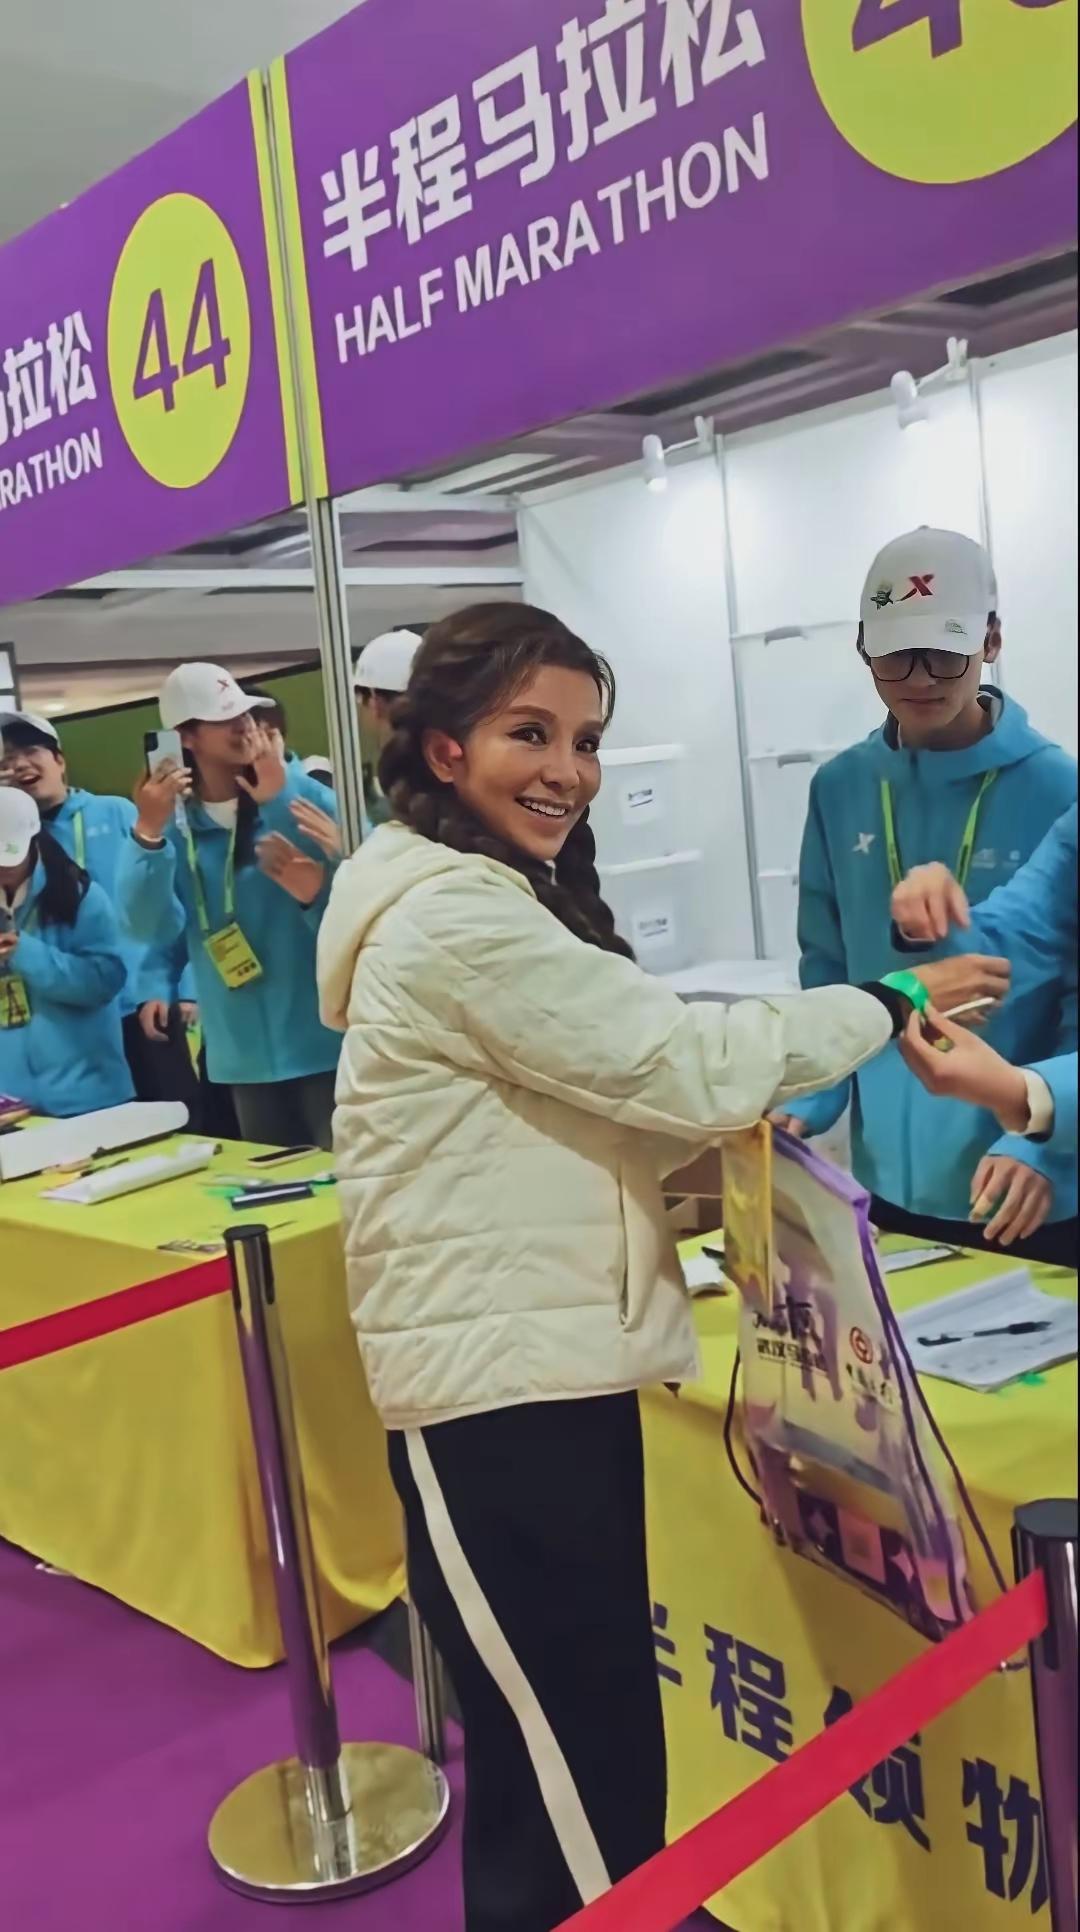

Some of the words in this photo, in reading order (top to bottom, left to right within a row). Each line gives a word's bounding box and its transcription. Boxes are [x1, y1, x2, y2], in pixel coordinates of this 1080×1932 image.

[322, 0, 767, 271] 半程马拉松
[334, 268, 445, 364] HALF
[455, 112, 770, 314] MARATHON
[0, 311, 97, 446] 拉松
[132, 257, 232, 414] 44
[0, 427, 103, 511] RATHON
